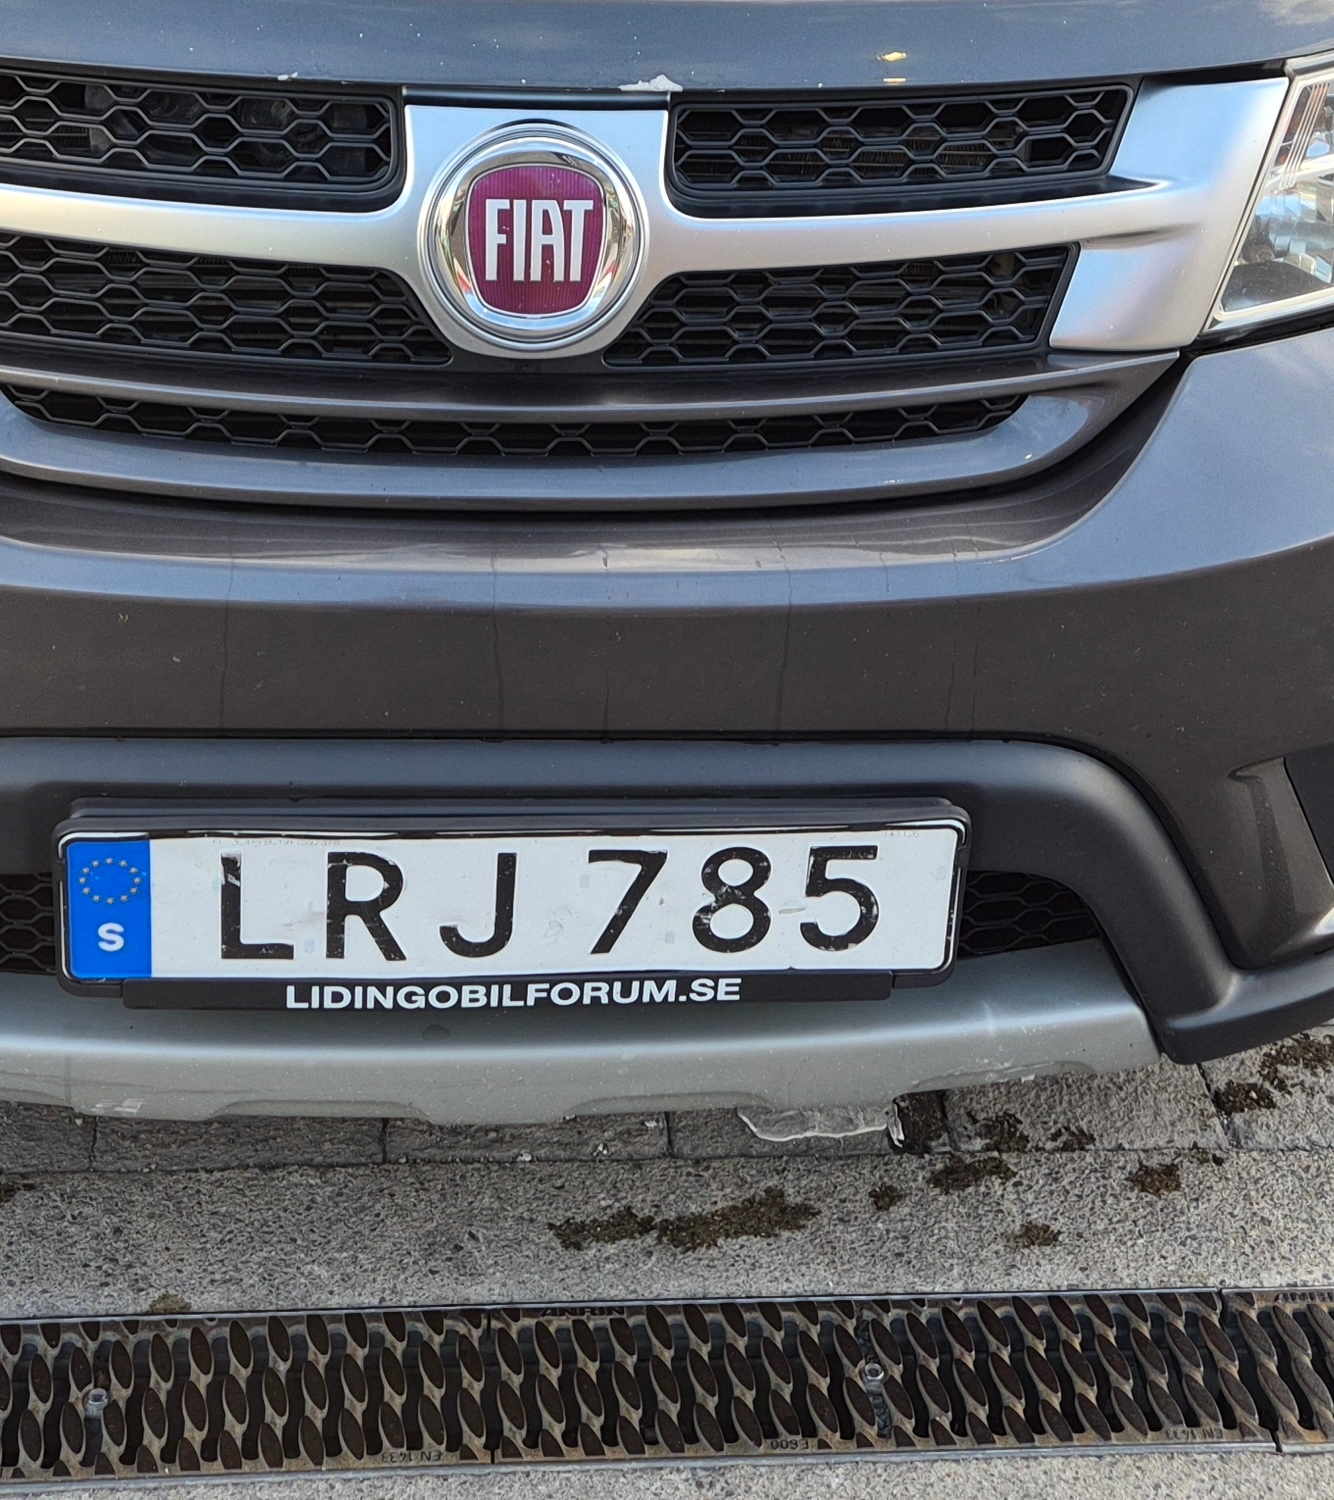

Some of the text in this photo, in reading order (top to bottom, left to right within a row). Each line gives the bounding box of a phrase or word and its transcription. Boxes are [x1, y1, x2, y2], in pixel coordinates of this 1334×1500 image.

[485, 198, 594, 282] FIAT
[220, 846, 880, 962] LRJ 785
[97, 921, 125, 952] S
[286, 978, 742, 1009] LIDINGOBILFORUM.SE
